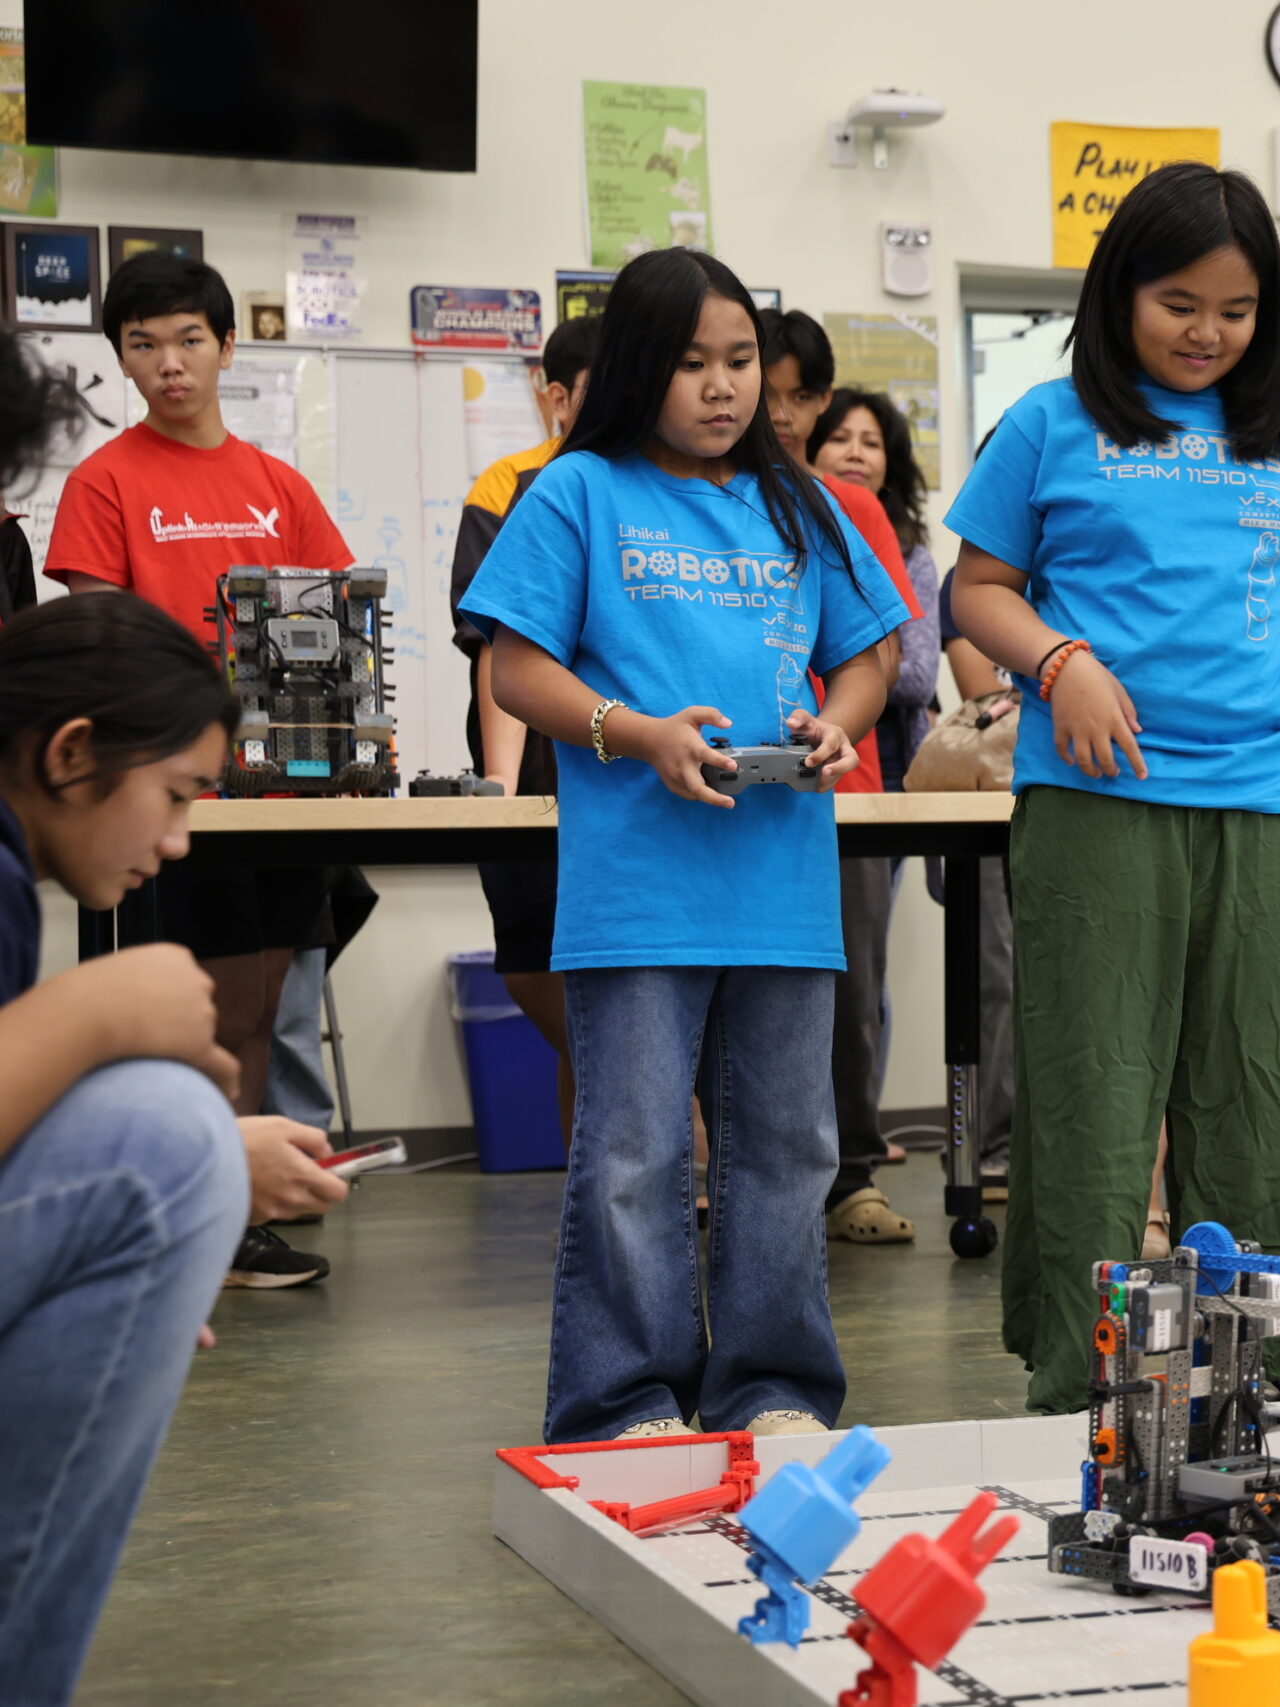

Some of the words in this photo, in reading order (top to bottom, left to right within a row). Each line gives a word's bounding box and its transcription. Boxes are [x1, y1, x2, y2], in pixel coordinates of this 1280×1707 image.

[1075, 142, 1139, 178] PLAY
[1059, 192, 1075, 213] A
[1098, 464, 1180, 481] TEAM
[1186, 467, 1246, 486] 11510
[1239, 491, 1280, 507] VEX
[618, 523, 671, 541] Lihikai
[624, 584, 704, 603] TEAM
[708, 591, 768, 608] 11510
[1142, 1548, 1183, 1573] 11510
[1186, 1553, 1197, 1580] B
